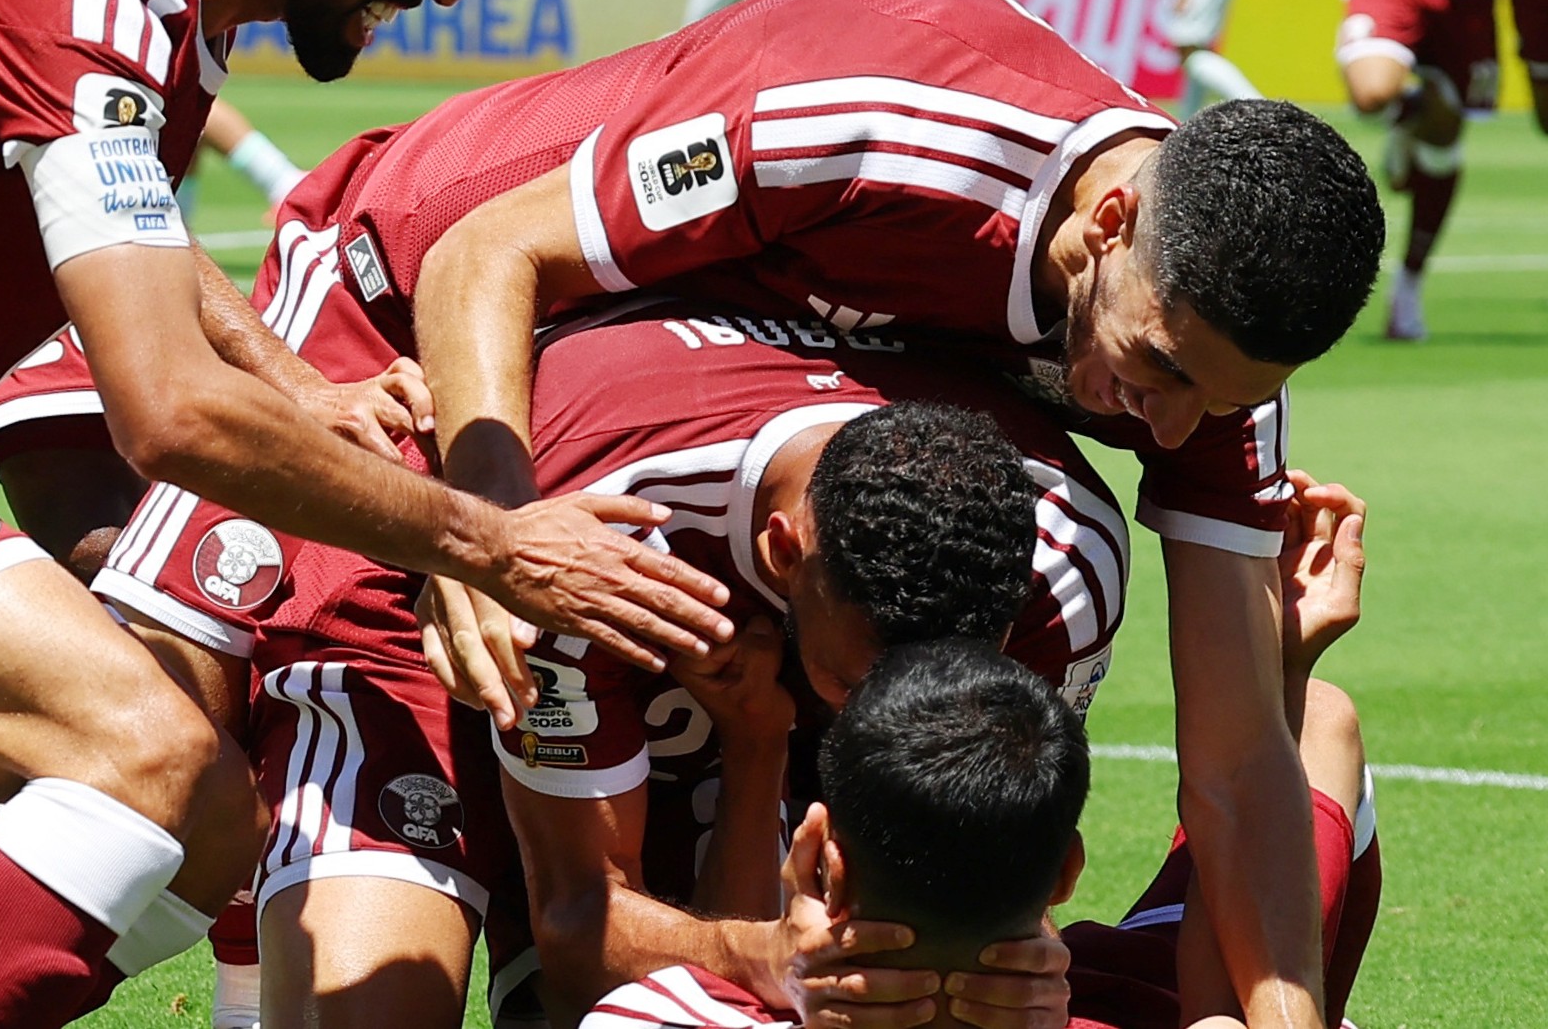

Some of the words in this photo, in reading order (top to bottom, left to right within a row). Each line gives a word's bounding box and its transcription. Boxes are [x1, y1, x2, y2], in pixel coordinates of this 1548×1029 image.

[94, 158, 170, 186] UNITE
[638, 161, 657, 205] 2026
[662, 163, 676, 186] FIFA
[98, 189, 138, 214] the
[137, 216, 166, 229] FIFA
[204, 575, 242, 606] QFA
[528, 717, 574, 728] 2026
[537, 747, 580, 756] DEBUT
[402, 823, 440, 846] QFA
